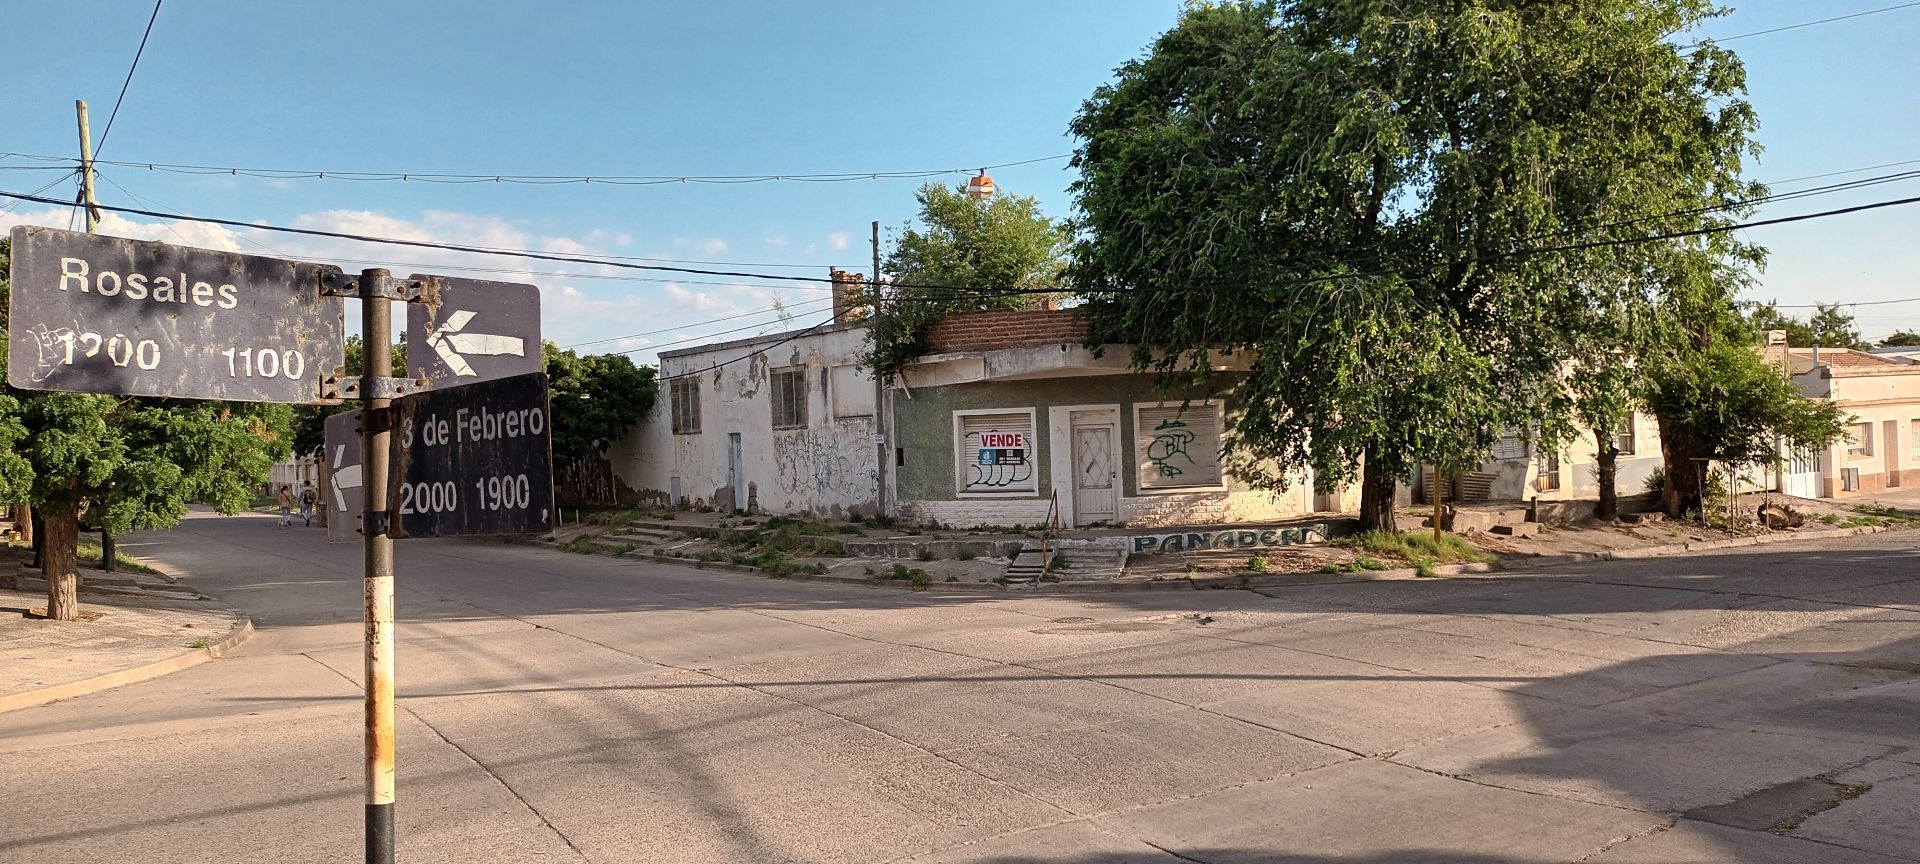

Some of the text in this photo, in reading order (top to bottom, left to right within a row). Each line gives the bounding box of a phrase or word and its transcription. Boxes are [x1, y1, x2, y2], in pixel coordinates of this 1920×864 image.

[59, 257, 238, 309] Rosales
[221, 347, 305, 380] 1100
[401, 406, 544, 449] 3 de Febrero
[981, 434, 1022, 447] VENDE
[400, 473, 530, 515] 2000 1900
[1134, 525, 1326, 552] PANADERI
